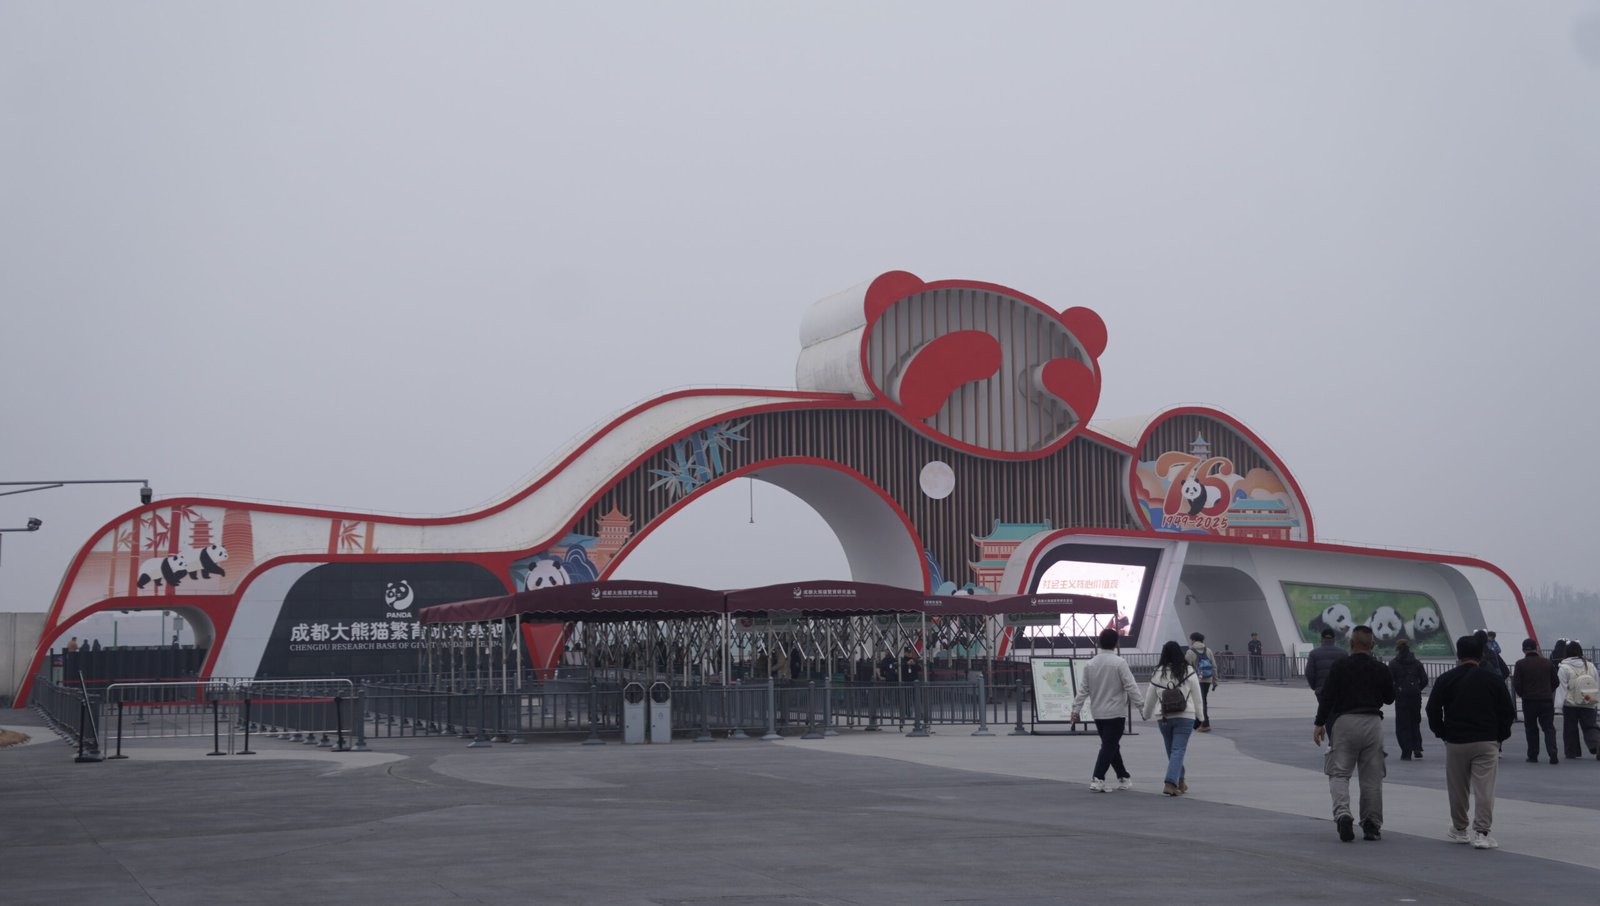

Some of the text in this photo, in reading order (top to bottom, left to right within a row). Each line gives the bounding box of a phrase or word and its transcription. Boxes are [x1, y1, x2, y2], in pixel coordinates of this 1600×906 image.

[1155, 451, 1233, 516] 76
[1162, 516, 1228, 528] 1949-2025
[289, 643, 330, 651] CHENGDU
[331, 642, 375, 650] RESEARCH
[376, 642, 397, 650] BASE
[410, 641, 437, 649] GIAT
